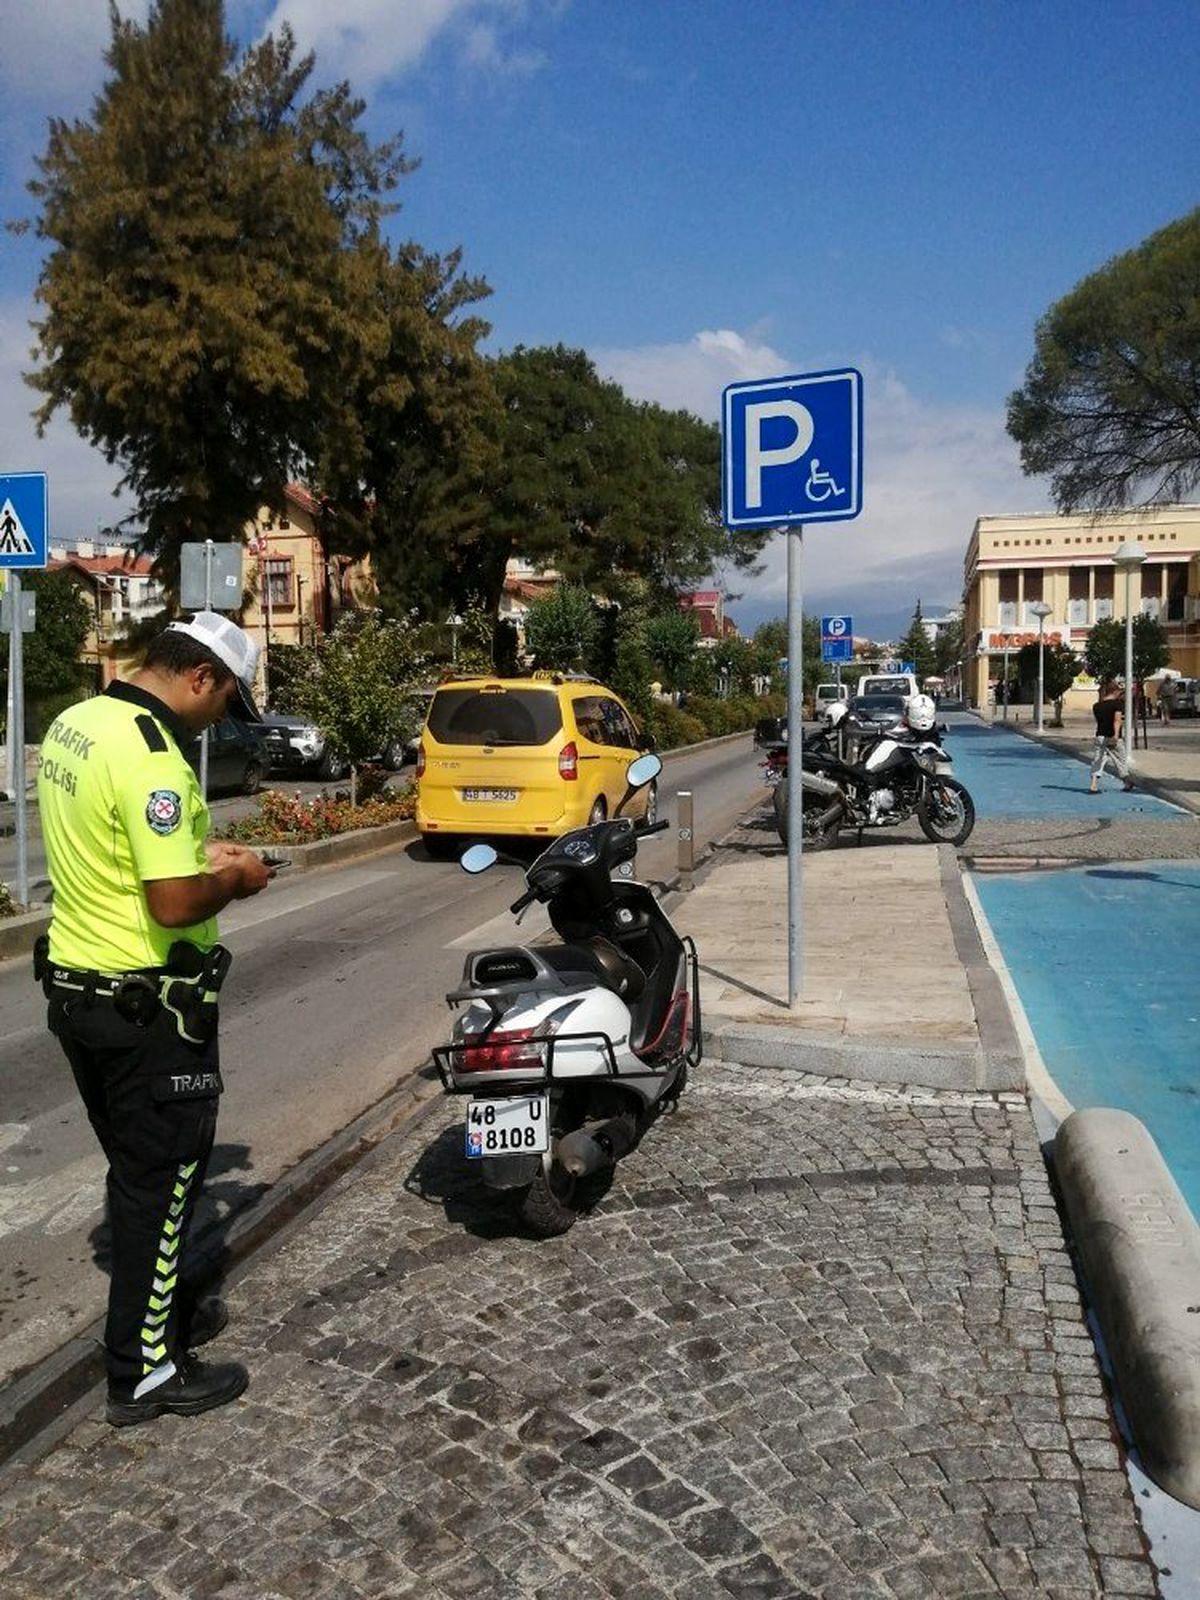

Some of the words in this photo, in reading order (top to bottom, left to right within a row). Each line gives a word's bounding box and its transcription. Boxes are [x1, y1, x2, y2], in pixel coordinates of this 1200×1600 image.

[744, 400, 815, 509] P
[832, 620, 844, 634] P
[471, 1105, 496, 1125] 48
[529, 1100, 541, 1121] U
[485, 1126, 536, 1150] 8108
